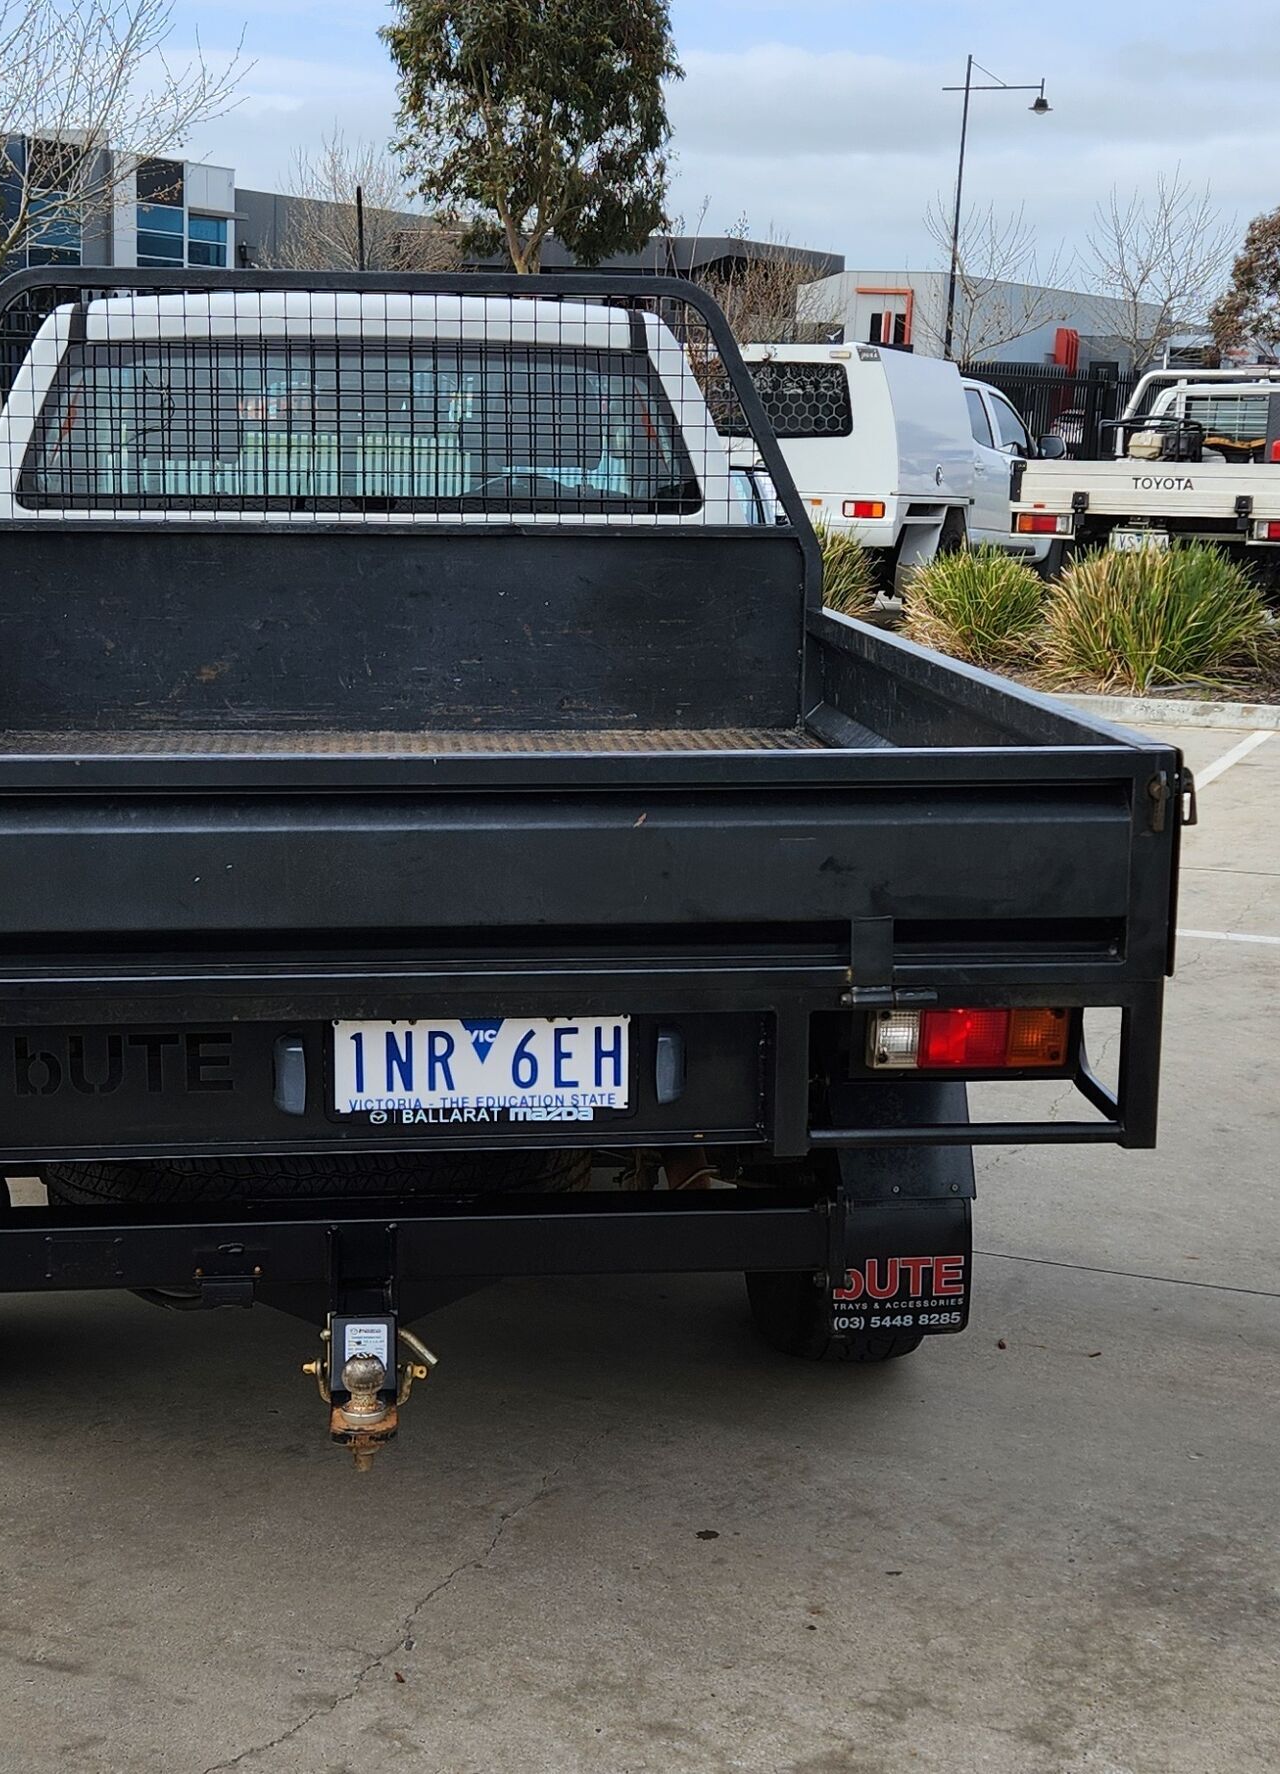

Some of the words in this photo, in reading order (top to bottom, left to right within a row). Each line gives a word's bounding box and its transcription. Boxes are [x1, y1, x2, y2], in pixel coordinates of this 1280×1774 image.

[1132, 477, 1194, 490] TOYOTA
[350, 1030, 455, 1093] 1NR
[511, 1025, 622, 1089] 6EH
[349, 1098, 423, 1110] VICTORIA
[440, 1096, 470, 1109] THE
[476, 1094, 565, 1107] EDUCATION
[570, 1092, 617, 1106] STATE
[402, 1107, 503, 1124] BALLARAT
[885, 1298, 964, 1309] ACCESSORIES
[833, 1316, 865, 1331] (03)
[869, 1314, 914, 1328] 5448
[918, 1311, 962, 1325] 8285
